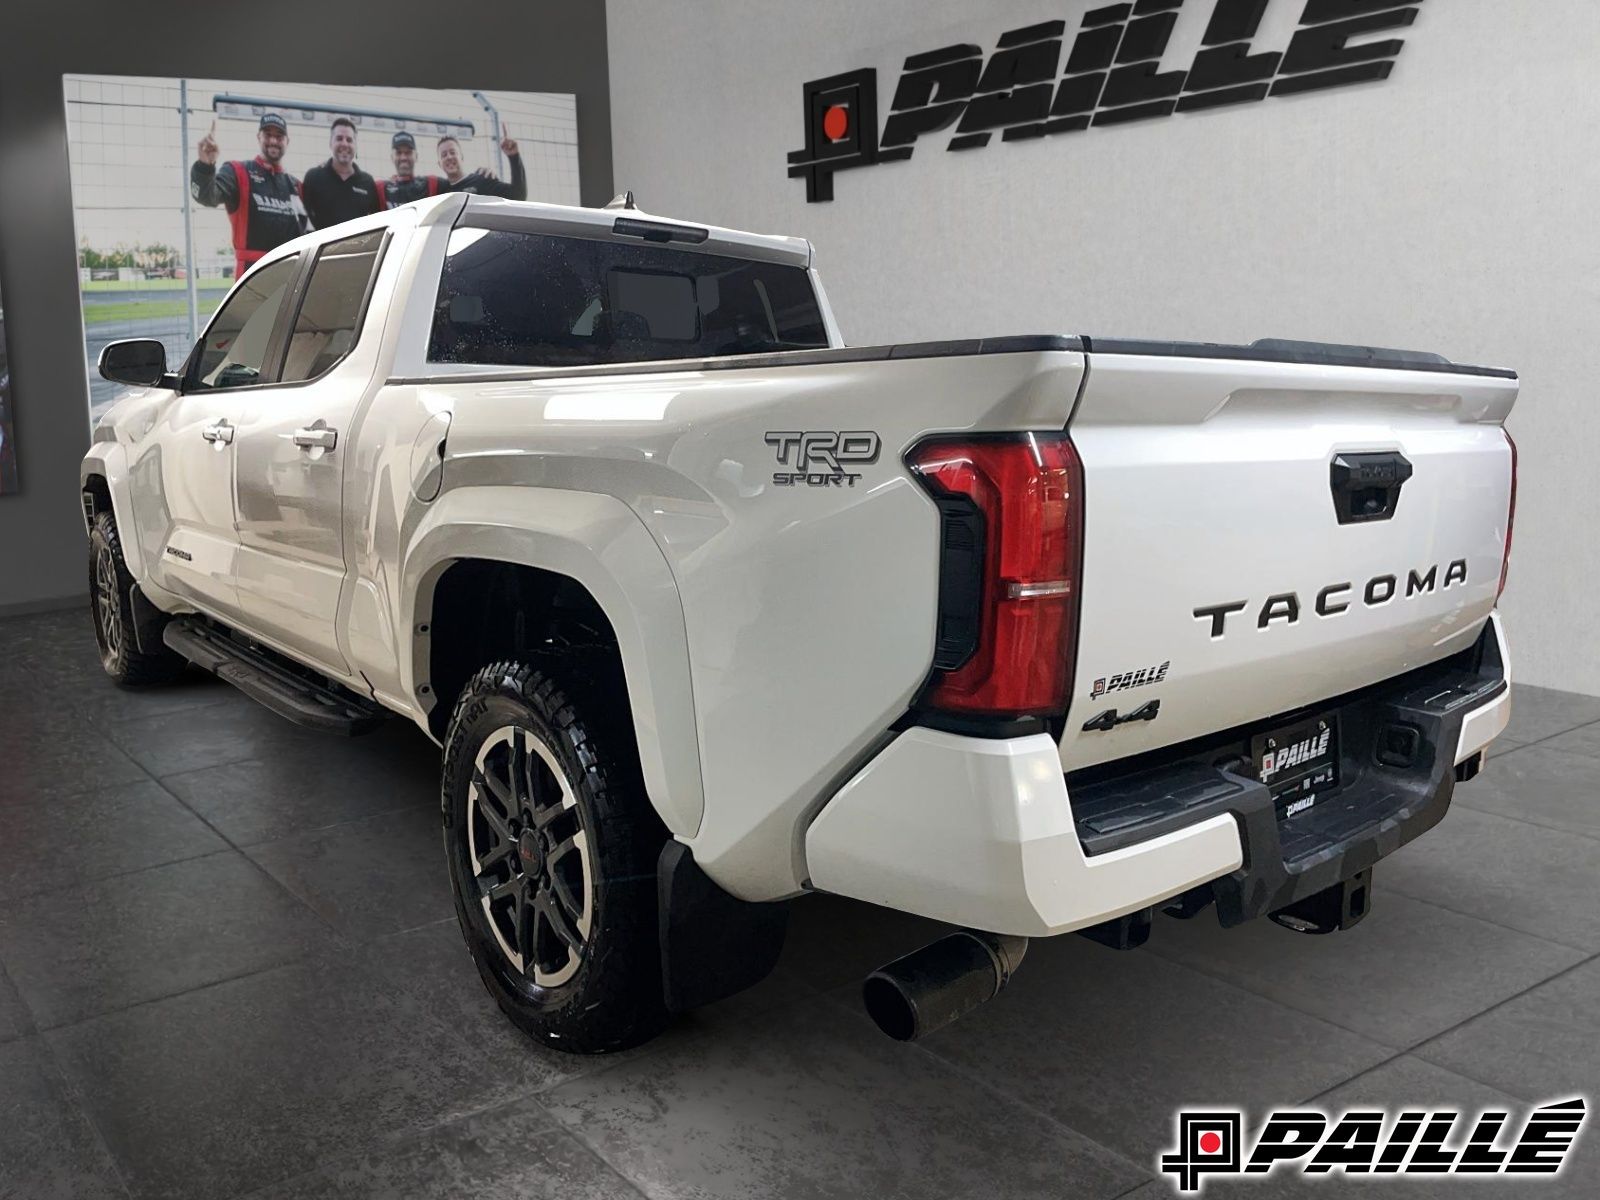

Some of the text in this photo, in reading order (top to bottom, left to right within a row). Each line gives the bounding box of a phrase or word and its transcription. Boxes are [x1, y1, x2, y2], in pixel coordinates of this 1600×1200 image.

[764, 431, 882, 474] TRD
[772, 472, 862, 488] SPORT
[1193, 558, 1467, 638] TACOMA
